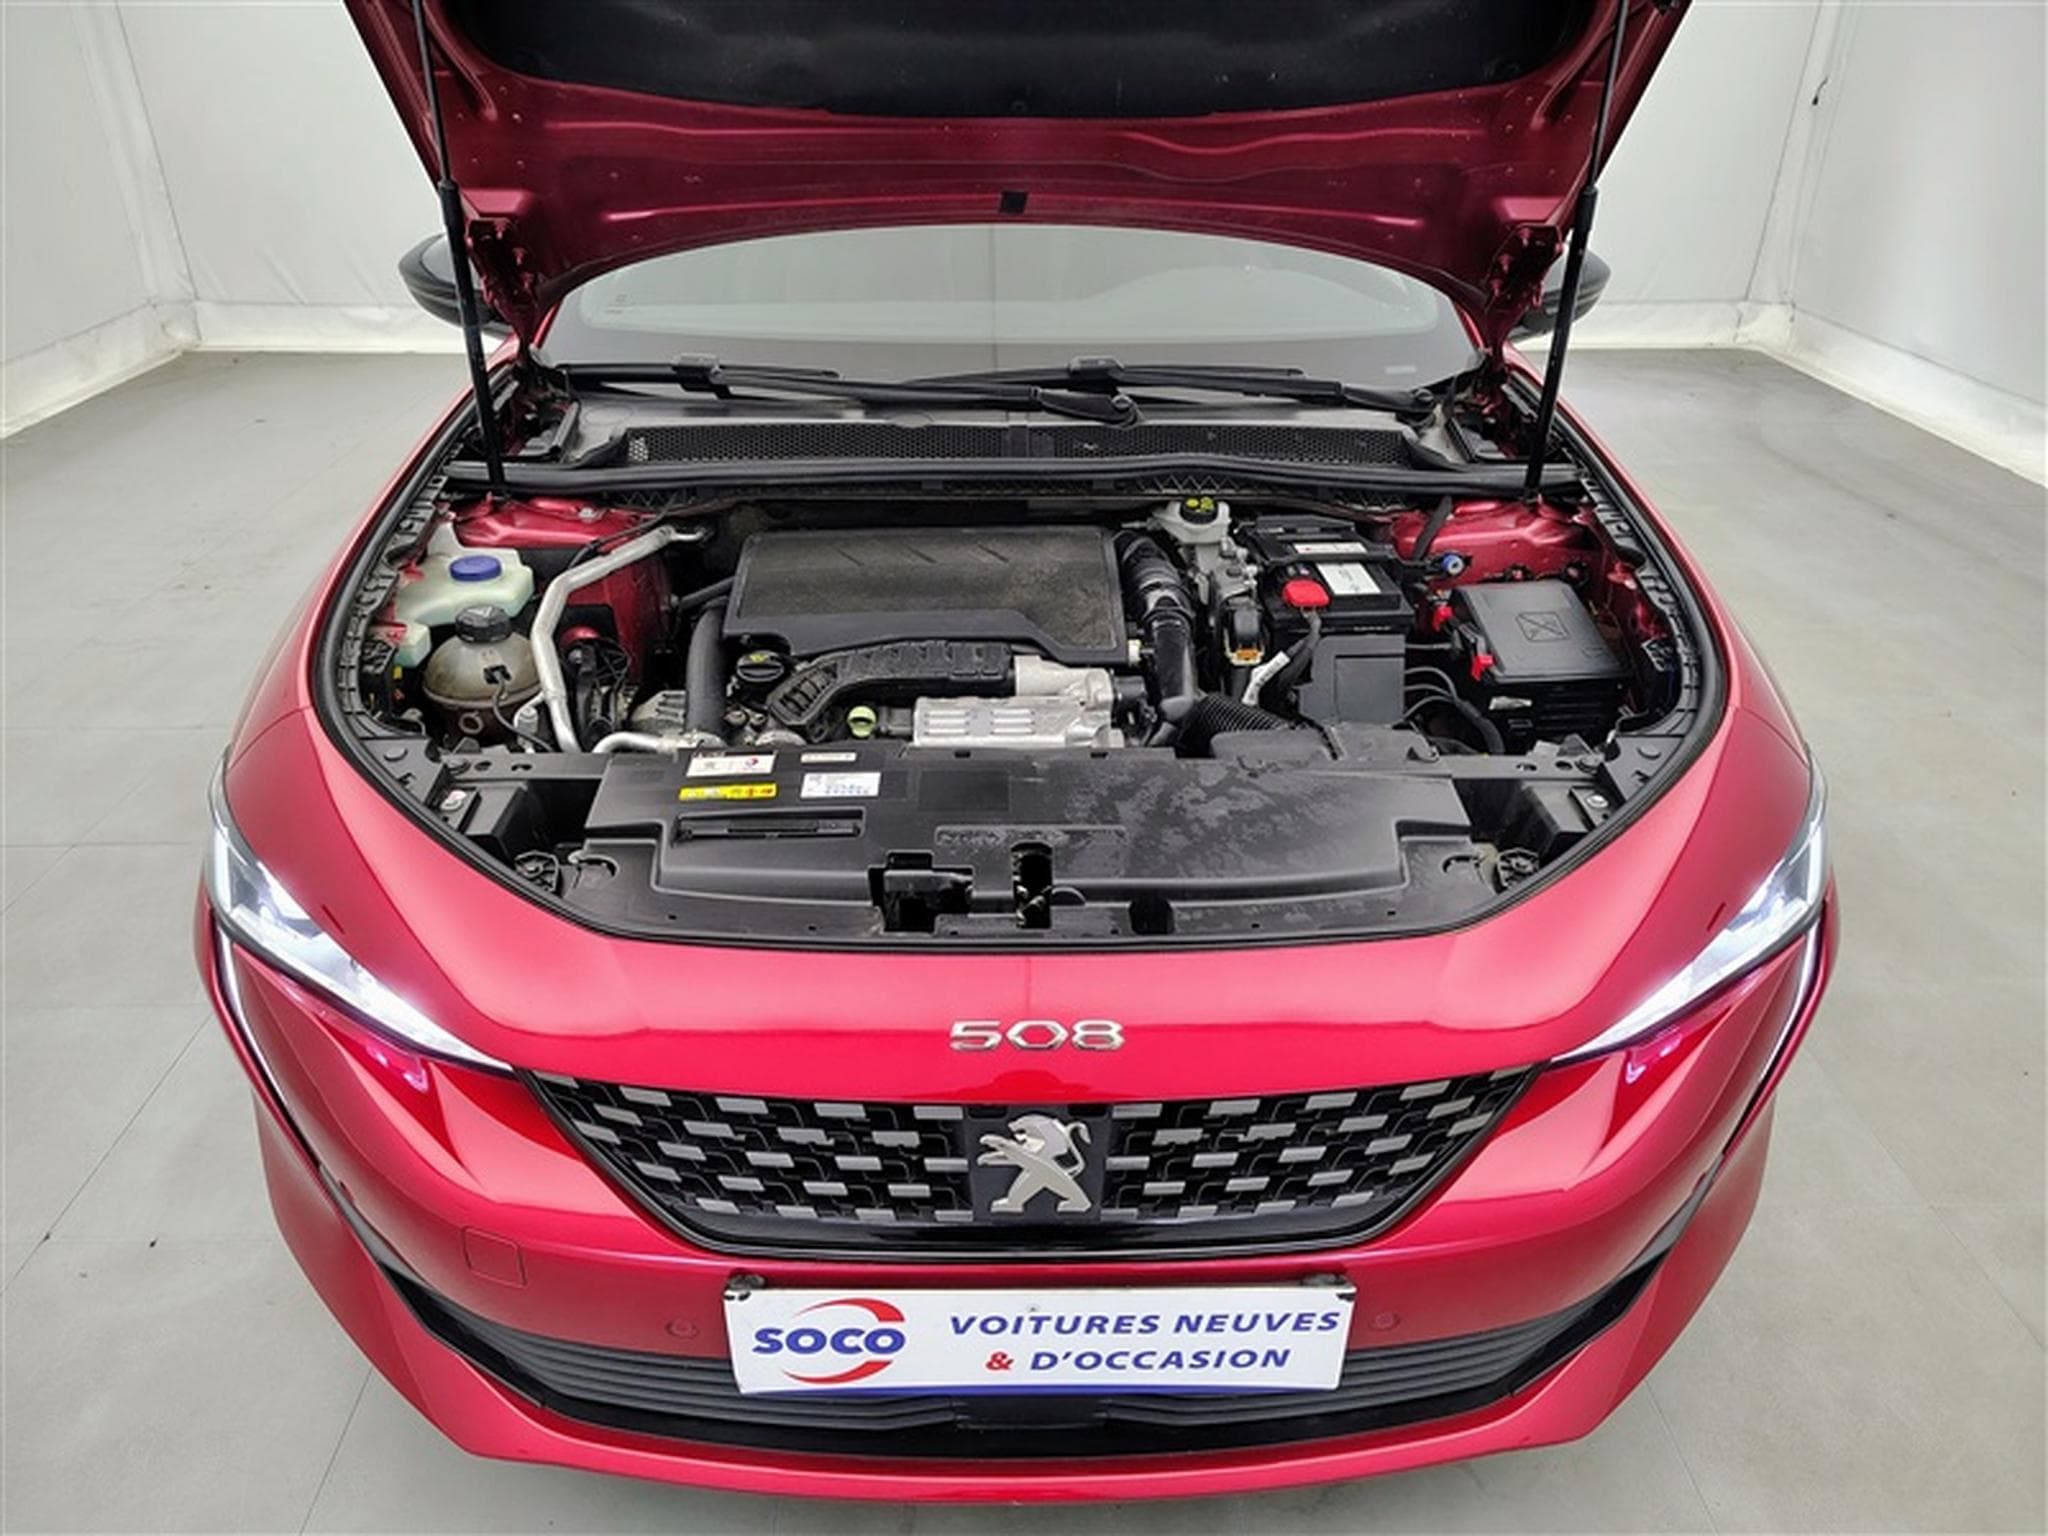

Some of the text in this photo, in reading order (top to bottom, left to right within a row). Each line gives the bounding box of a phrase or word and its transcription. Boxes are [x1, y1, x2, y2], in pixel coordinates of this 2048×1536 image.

[950, 1019, 1125, 1051] 508
[949, 1310, 1341, 1337] VOITURES NEUVES
[751, 1326, 907, 1356] SOCO
[986, 1347, 1291, 1372] & D'OCCASION
